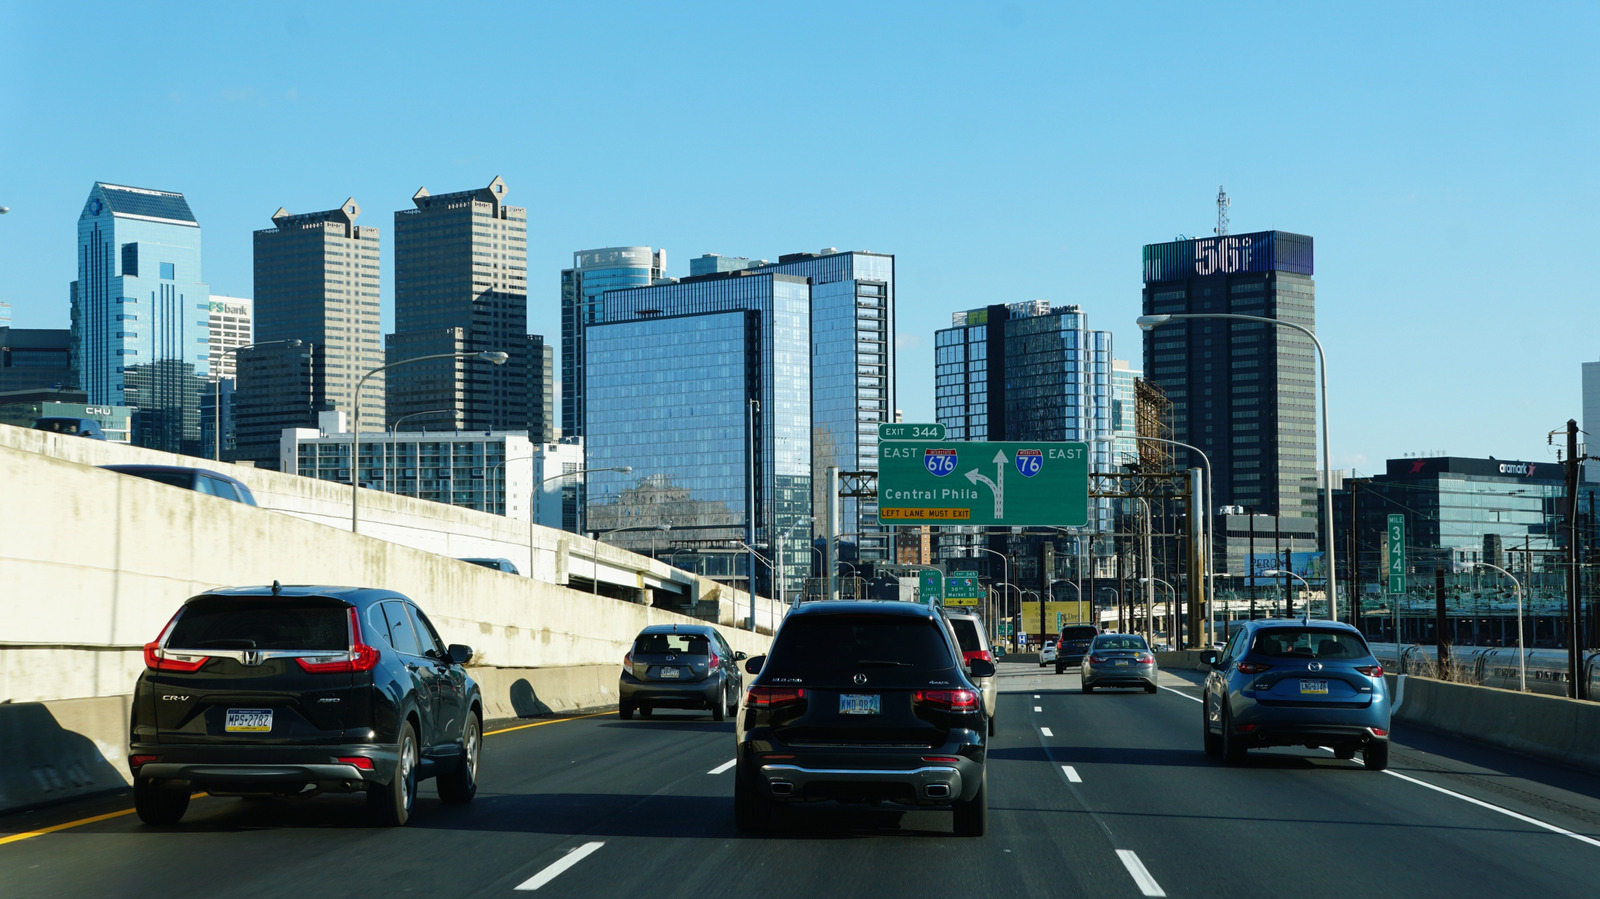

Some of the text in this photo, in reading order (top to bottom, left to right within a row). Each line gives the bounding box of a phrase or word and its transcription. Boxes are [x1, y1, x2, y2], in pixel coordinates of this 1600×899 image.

[86, 407, 110, 415] CHU
[885, 427, 938, 437] EXIT 344
[883, 448, 917, 458] EAST
[1049, 449, 1082, 459] EAST
[928, 456, 954, 471] 676
[1018, 456, 1040, 472] 76
[1499, 463, 1527, 474] aramark
[885, 488, 978, 500] Central Phila
[881, 510, 969, 518] LEFT LANE MUST EXIT
[162, 694, 190, 702] CR-V
